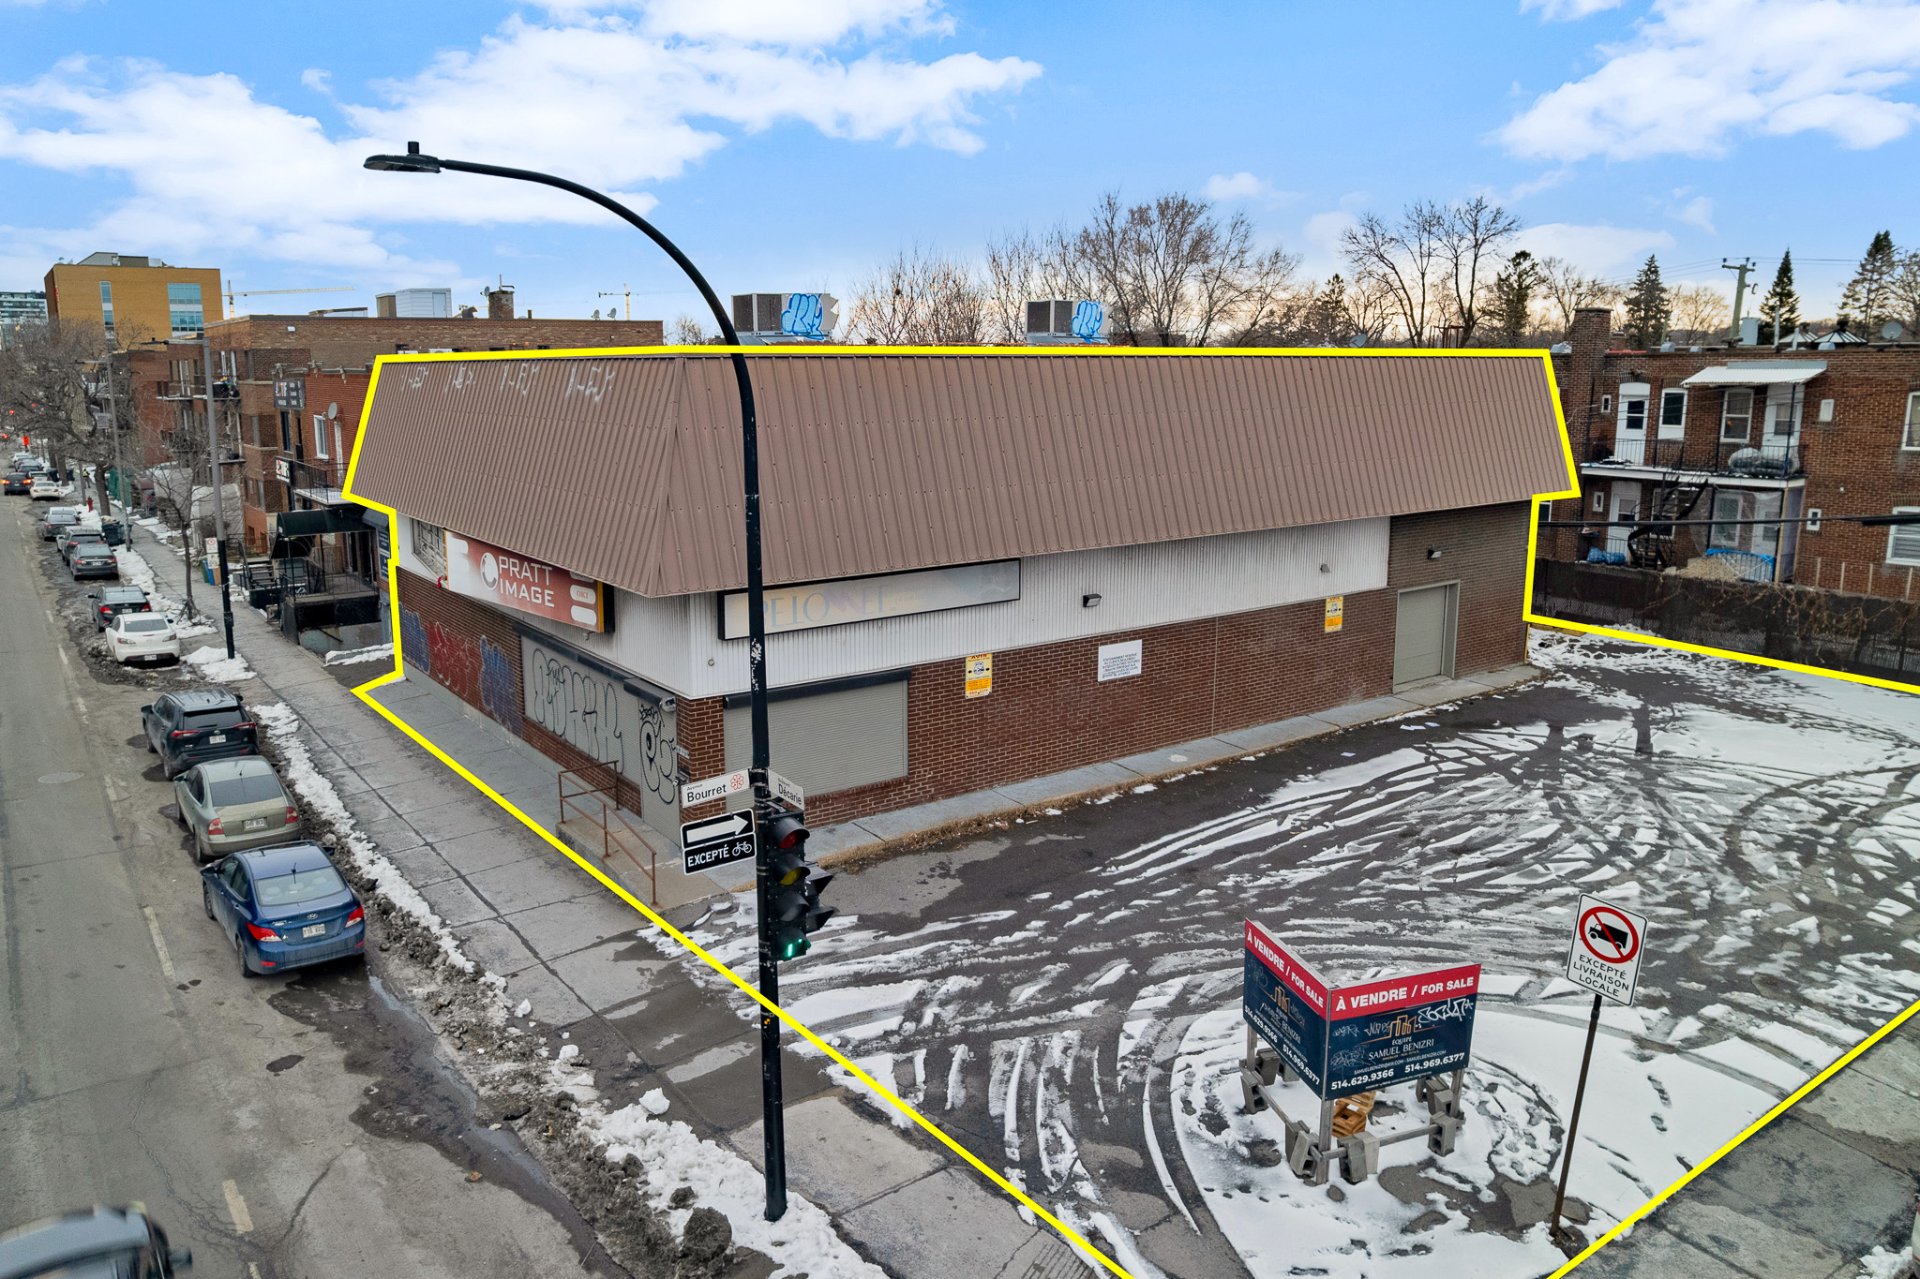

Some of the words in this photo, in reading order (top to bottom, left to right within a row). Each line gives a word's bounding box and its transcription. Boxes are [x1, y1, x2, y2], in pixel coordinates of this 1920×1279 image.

[499, 556, 552, 585] PRATT
[500, 578, 554, 607] IMAGE
[687, 784, 727, 803] Bourret
[778, 783, 802, 805] Décarie
[687, 844, 730, 868] EXCEPTÉ
[1247, 928, 1253, 944] À
[1253, 935, 1285, 972] VENDRE
[1285, 965, 1291, 976] /
[1291, 971, 1305, 992] FOR
[1305, 985, 1324, 1009] SALE
[1573, 961, 1629, 992] LIVRAISON
[1579, 954, 1627, 980] EXCEPTÉ
[1335, 996, 1346, 1012] À
[1351, 987, 1408, 1009] VENDRE
[1411, 985, 1417, 998] /
[1421, 982, 1443, 996] FOR
[1446, 977, 1474, 991] SALE
[1579, 974, 1619, 997] LOCALE
[1368, 1046, 1400, 1060] SAMUEL
[1402, 1038, 1434, 1052] BENIZRI
[1331, 1068, 1394, 1090] 514.629.9366
[1404, 1052, 1465, 1073] 514.969.6377
